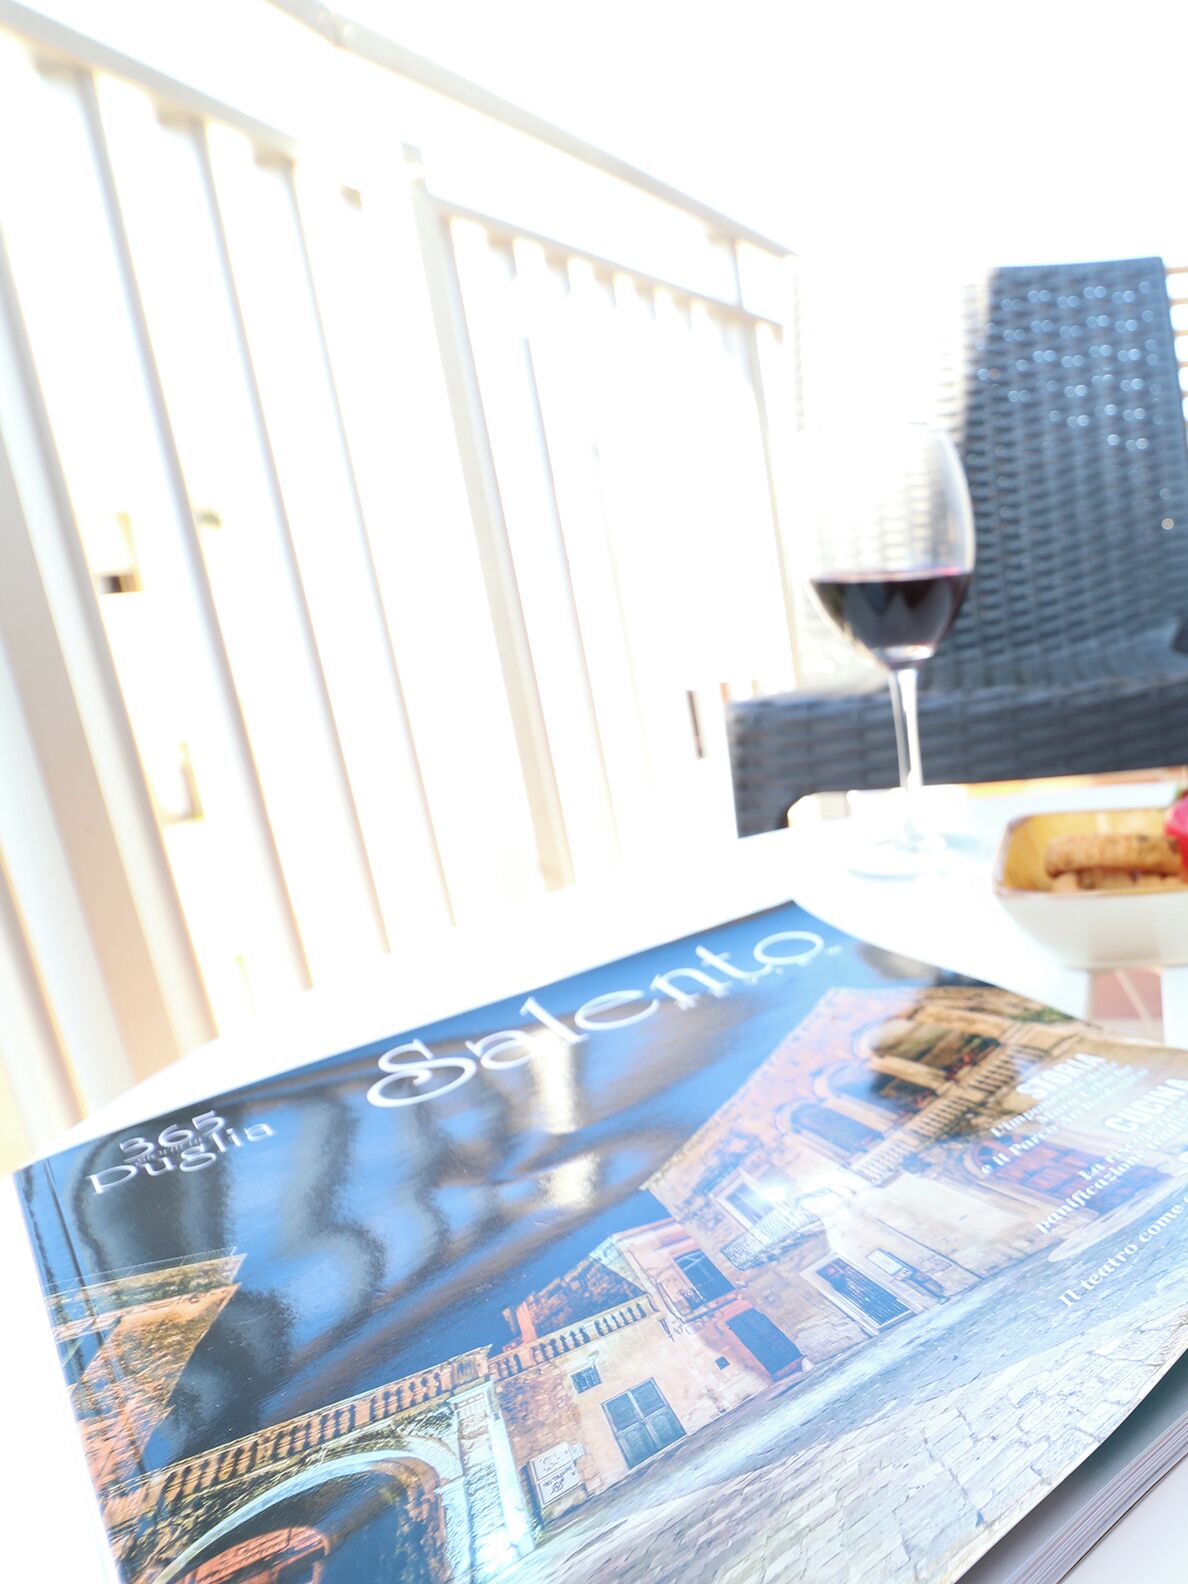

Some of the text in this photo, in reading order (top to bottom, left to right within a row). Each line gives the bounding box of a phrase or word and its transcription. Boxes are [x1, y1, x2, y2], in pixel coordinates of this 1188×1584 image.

[367, 930, 825, 1108] Salento
[1016, 1052, 1107, 1100] STORIA
[119, 1110, 227, 1163] 365
[980, 1163, 993, 1175] e
[992, 1152, 1011, 1166] il
[1008, 1125, 1058, 1157] Parco
[1036, 1149, 1145, 1235] panificazione
[1078, 1162, 1106, 1181] La
[1058, 1289, 1081, 1307] Il
[1080, 1243, 1138, 1291] teatro
[1138, 1204, 1184, 1243] come
